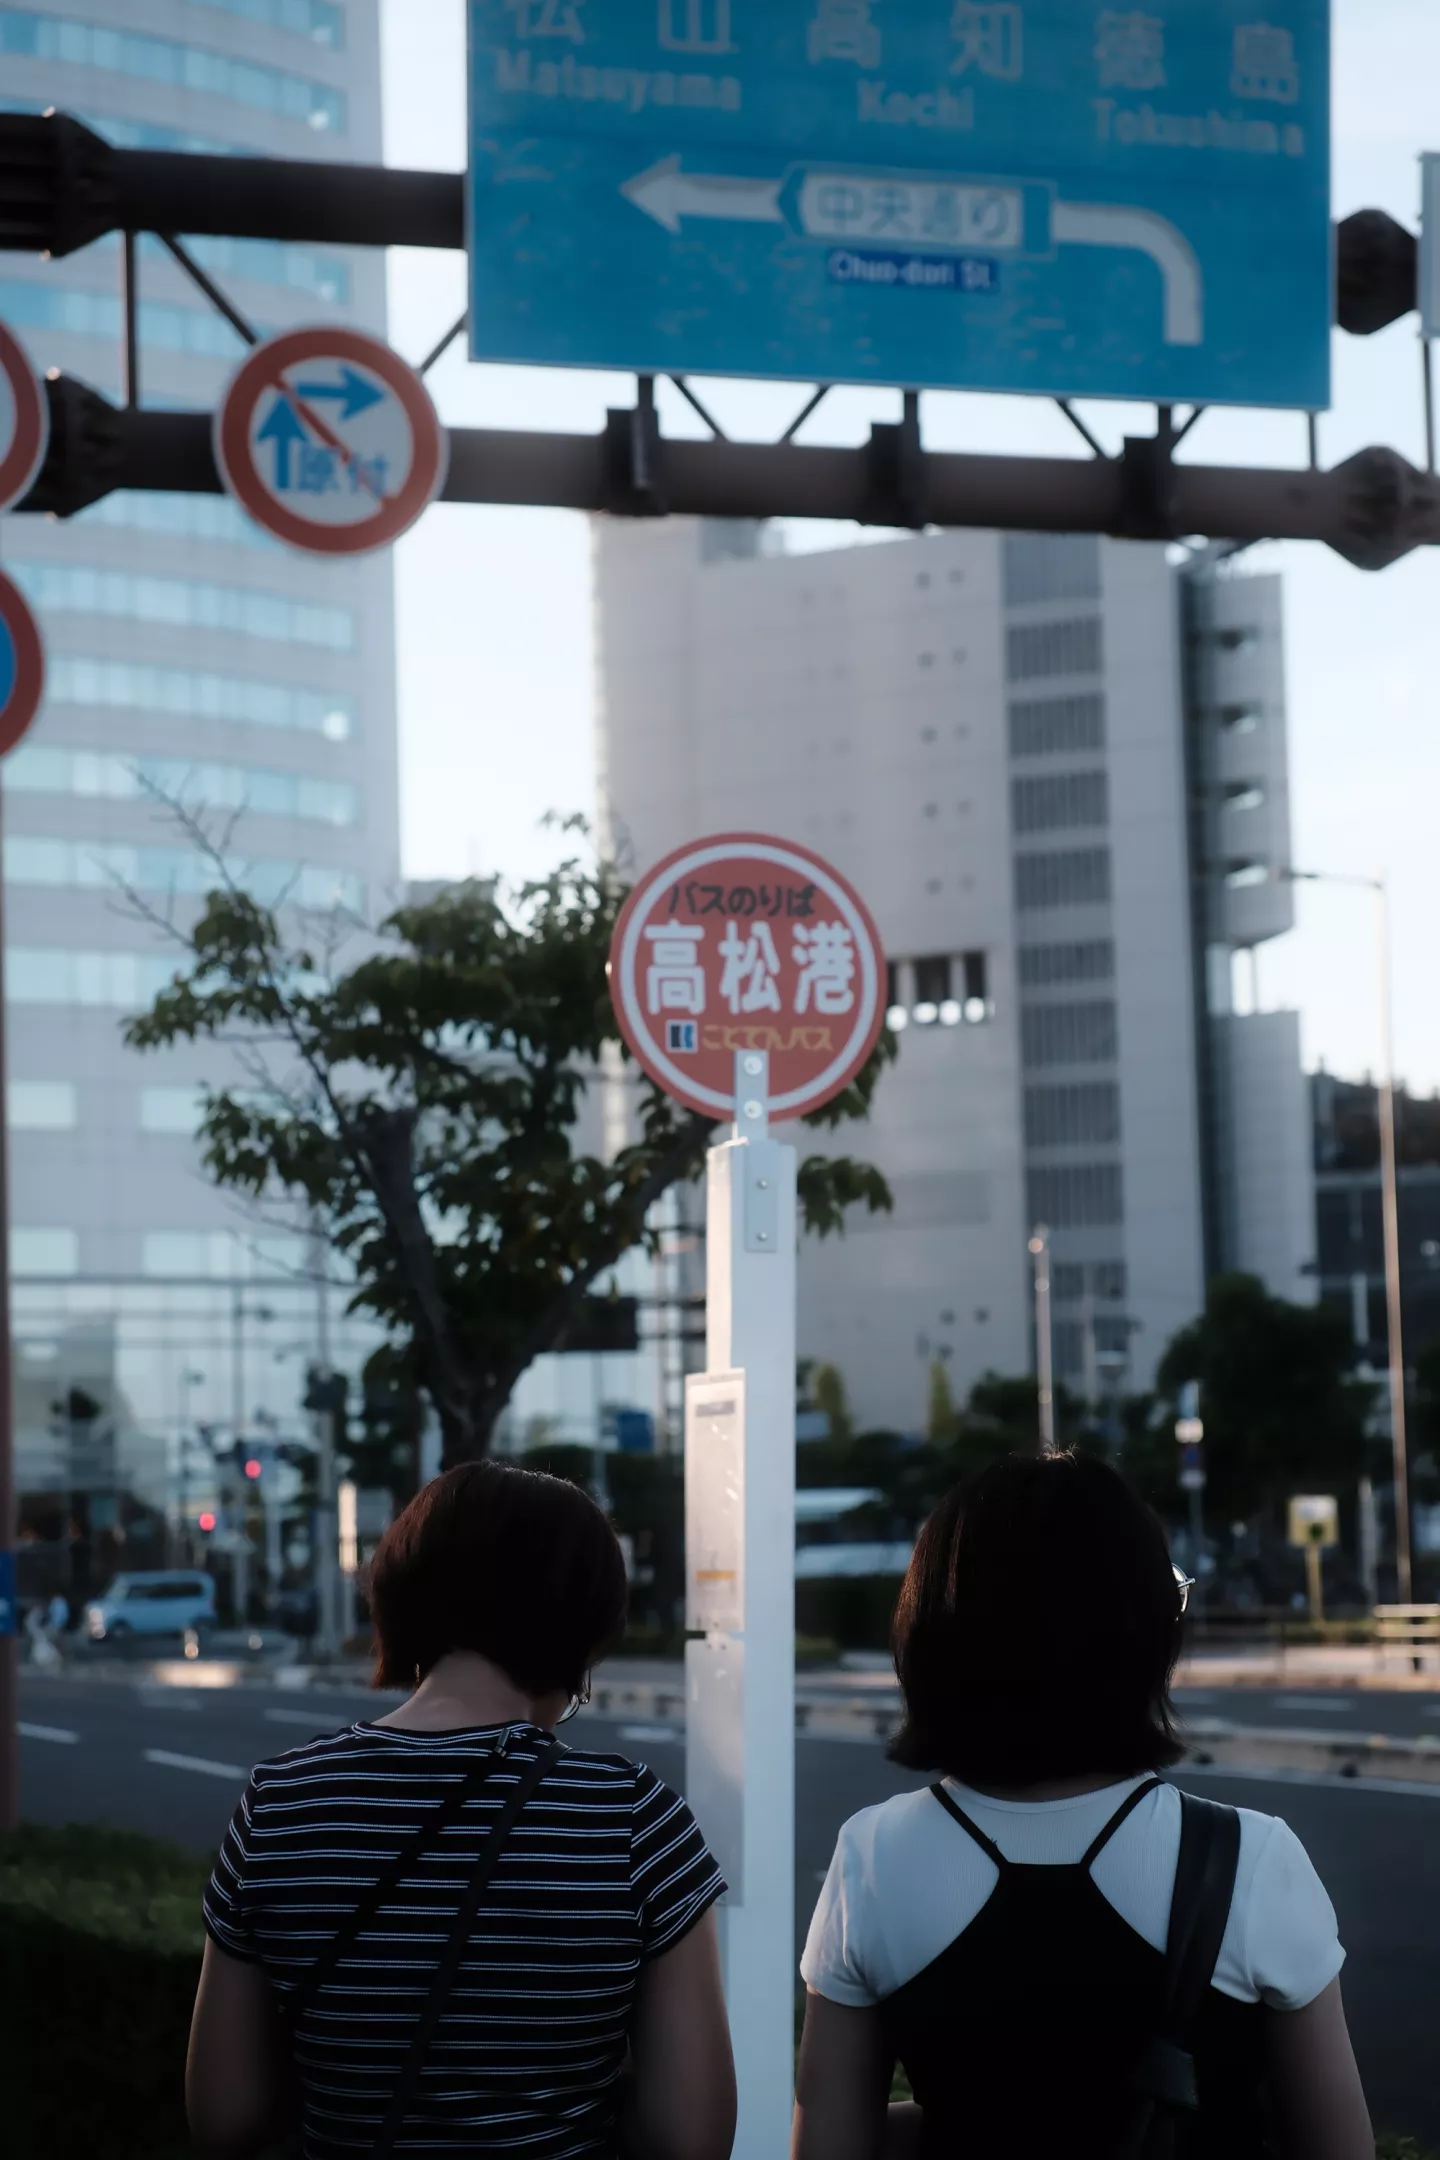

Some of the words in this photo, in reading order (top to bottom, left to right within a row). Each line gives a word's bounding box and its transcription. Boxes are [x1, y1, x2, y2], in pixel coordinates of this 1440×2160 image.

[496, 46, 742, 114] Matsuyama
[856, 77, 975, 131] Kochi
[1089, 98, 1304, 157] Tokushima
[816, 183, 1010, 241] 中央通り
[668, 881, 817, 918] バスのりば
[643, 918, 856, 1016] 高松港
